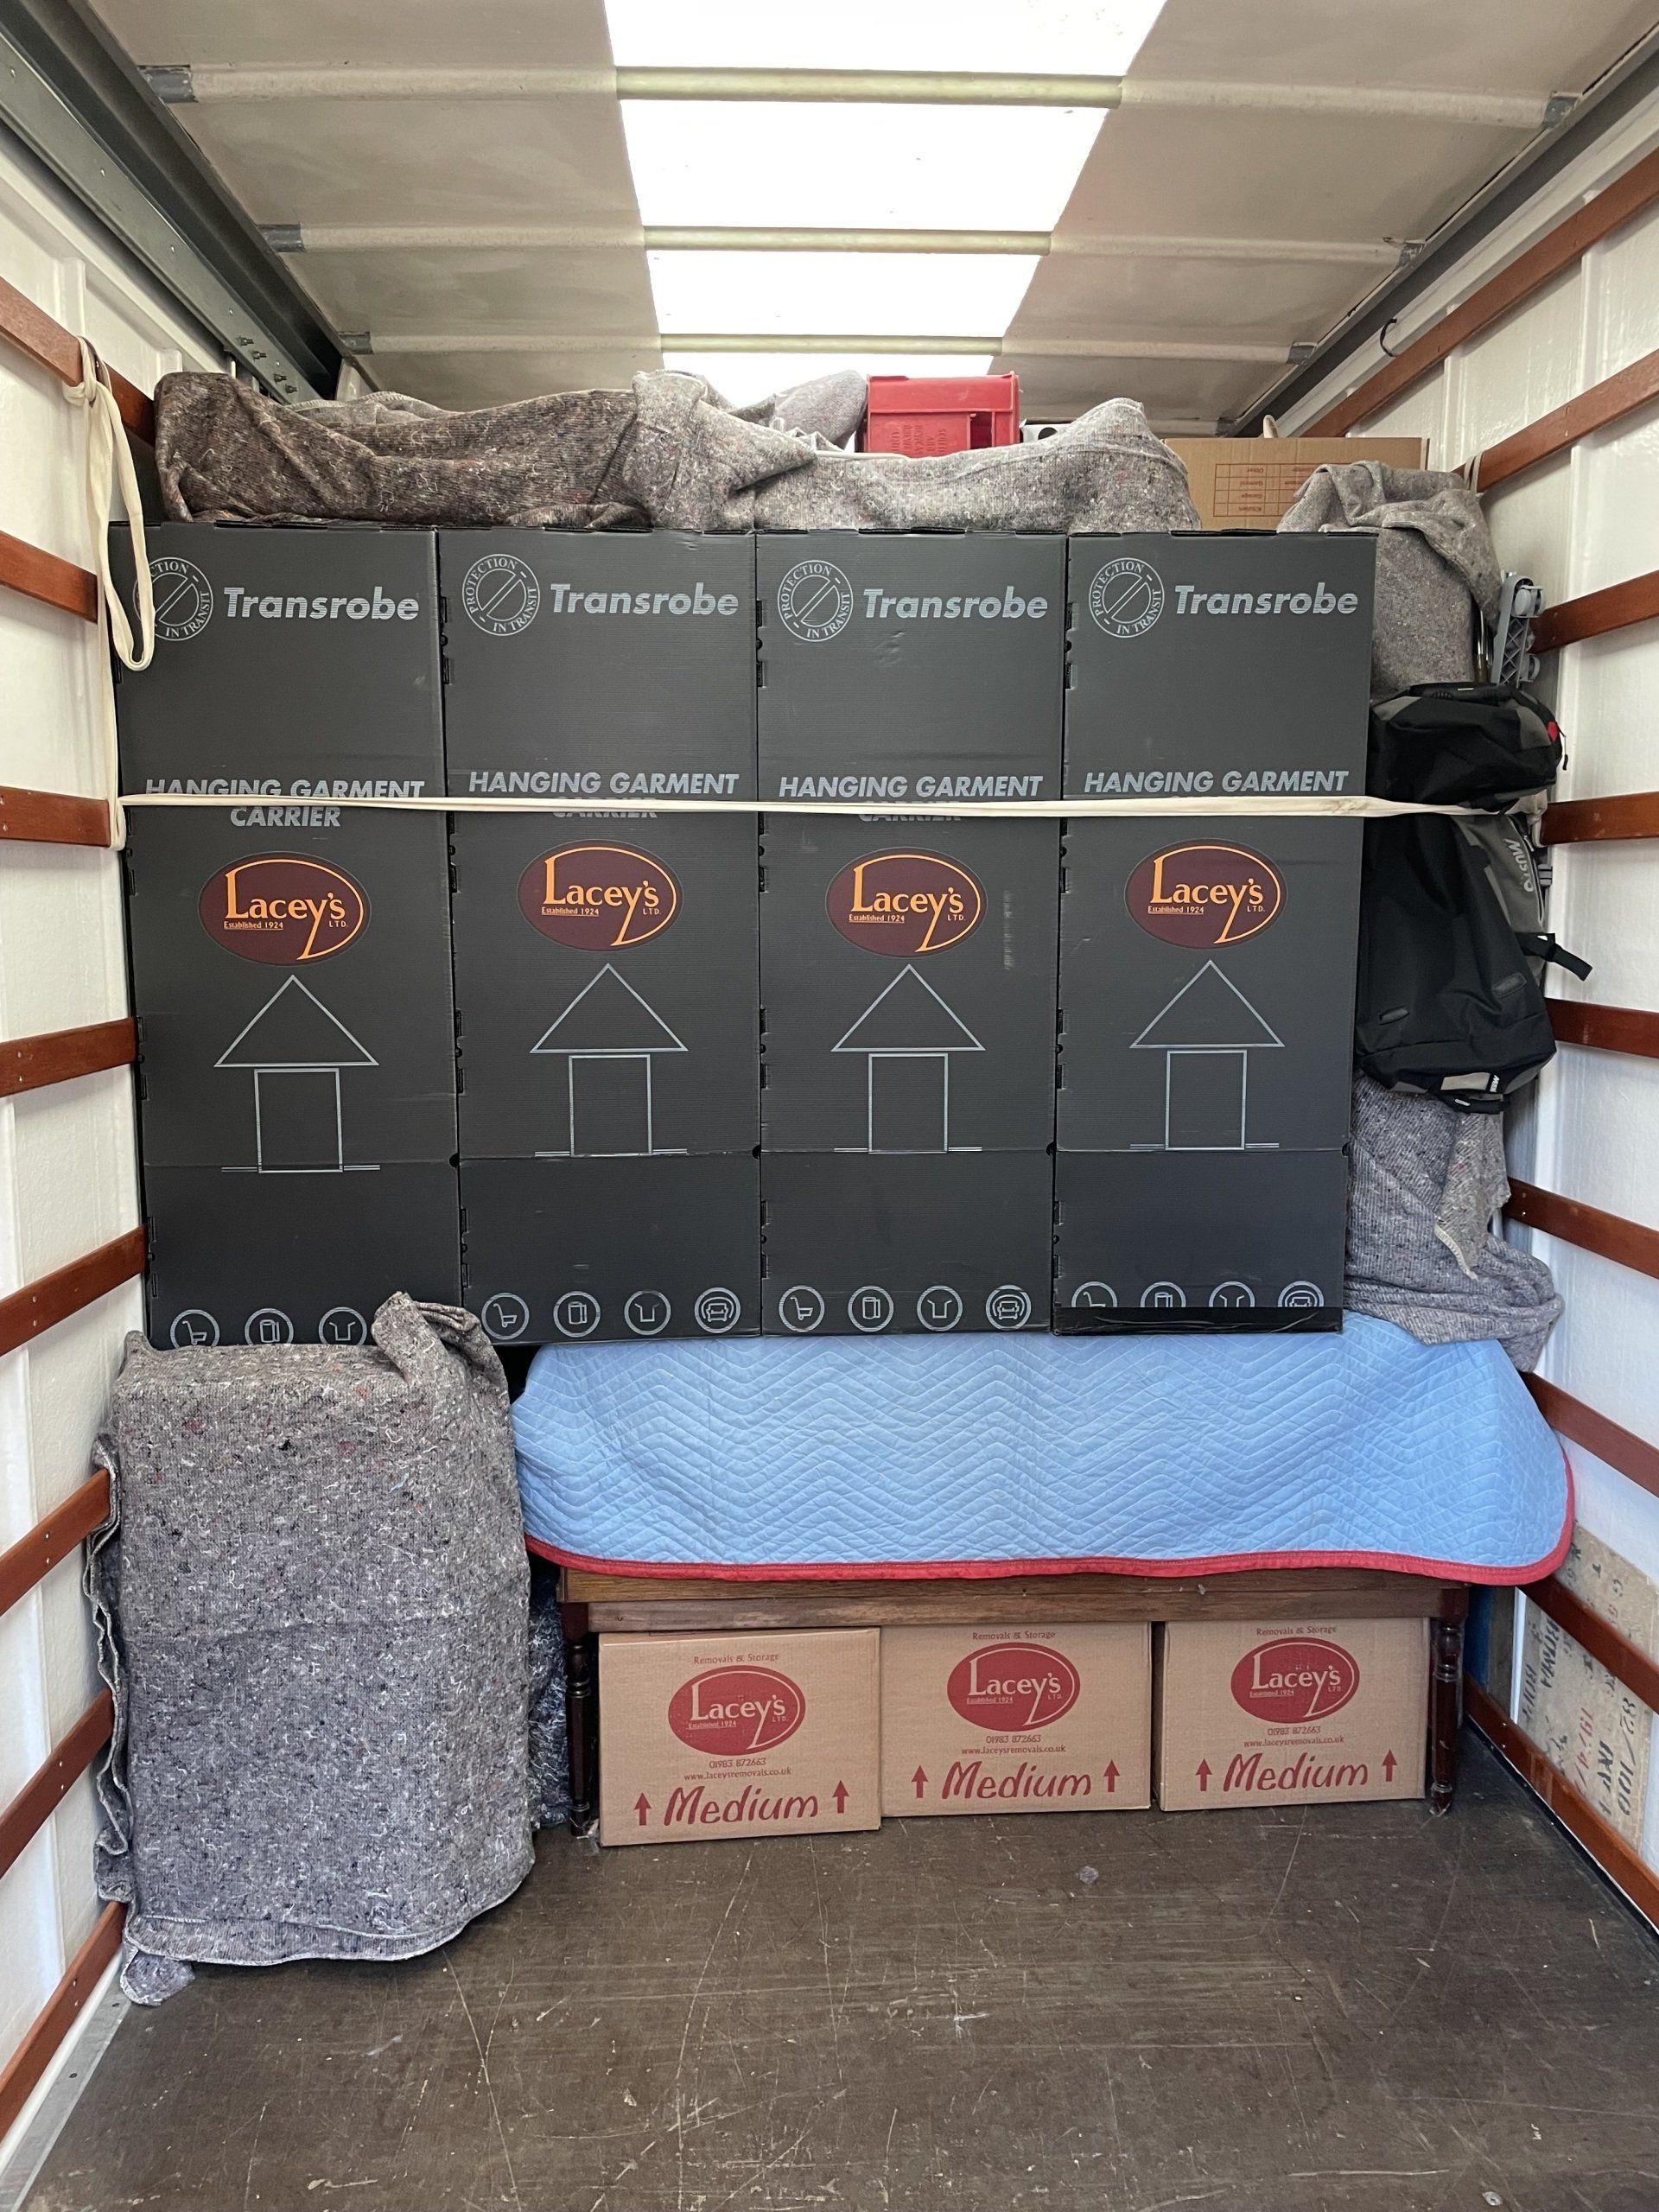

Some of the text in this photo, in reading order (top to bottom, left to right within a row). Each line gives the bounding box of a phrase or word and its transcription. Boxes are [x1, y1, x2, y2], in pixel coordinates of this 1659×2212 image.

[466, 557, 518, 614] PROTECTION
[550, 582, 739, 616] Transrobe
[781, 563, 832, 620] PROTECTION
[863, 585, 1048, 619] Transrobe
[1092, 561, 1145, 617] PROTECTION
[1174, 582, 1358, 614] Transrobe
[165, 591, 210, 638] IN TRANSIT
[224, 586, 419, 620] Transrobe
[493, 587, 537, 633] IN TRANSIT
[806, 592, 850, 639] IN TRANSIT
[1116, 588, 1161, 634] IN TRANSIT
[146, 779, 425, 798] HANGING GARMENT
[468, 771, 740, 794] HANGING GARMENT
[779, 775, 1044, 798] HANGING GARMENT
[1084, 770, 1350, 792] HANGING GARMENT
[230, 805, 341, 827] CARRIER
[225, 871, 346, 961] Lacey's
[542, 906, 578, 916] Established
[543, 858, 659, 947] Lacey's
[850, 866, 963, 953] Lacey's
[1147, 906, 1184, 914] Established
[1150, 857, 1264, 944] Lacey's
[224, 921, 283, 930] Established 1924
[972, 1631, 1011, 1641] Removals
[1025, 1630, 1055, 1640] Storage
[1256, 1626, 1294, 1636] Removals
[1306, 1625, 1337, 1635] Storage
[694, 1654, 734, 1664] Removals
[747, 1652, 779, 1662] Storage
[968, 1658, 1061, 1726] Lacey's
[1250, 1654, 1341, 1718] Lacey's
[690, 1683, 785, 1750] Lacey's
[1267, 1726, 1321, 1736] 01983 872663
[961, 1745, 1067, 1756] www.laceysremovals.co.uk
[986, 1734, 1041, 1744] 01983 872663
[1243, 1735, 1344, 1748] www.laceysremovals.co.uk
[684, 1766, 791, 1782] www.laceysremovals.co.uk
[709, 1758, 766, 1769] 01983 872663
[941, 1760, 1092, 1800] Medium
[1224, 1752, 1369, 1792] Medium
[664, 1784, 818, 1827] Medium
